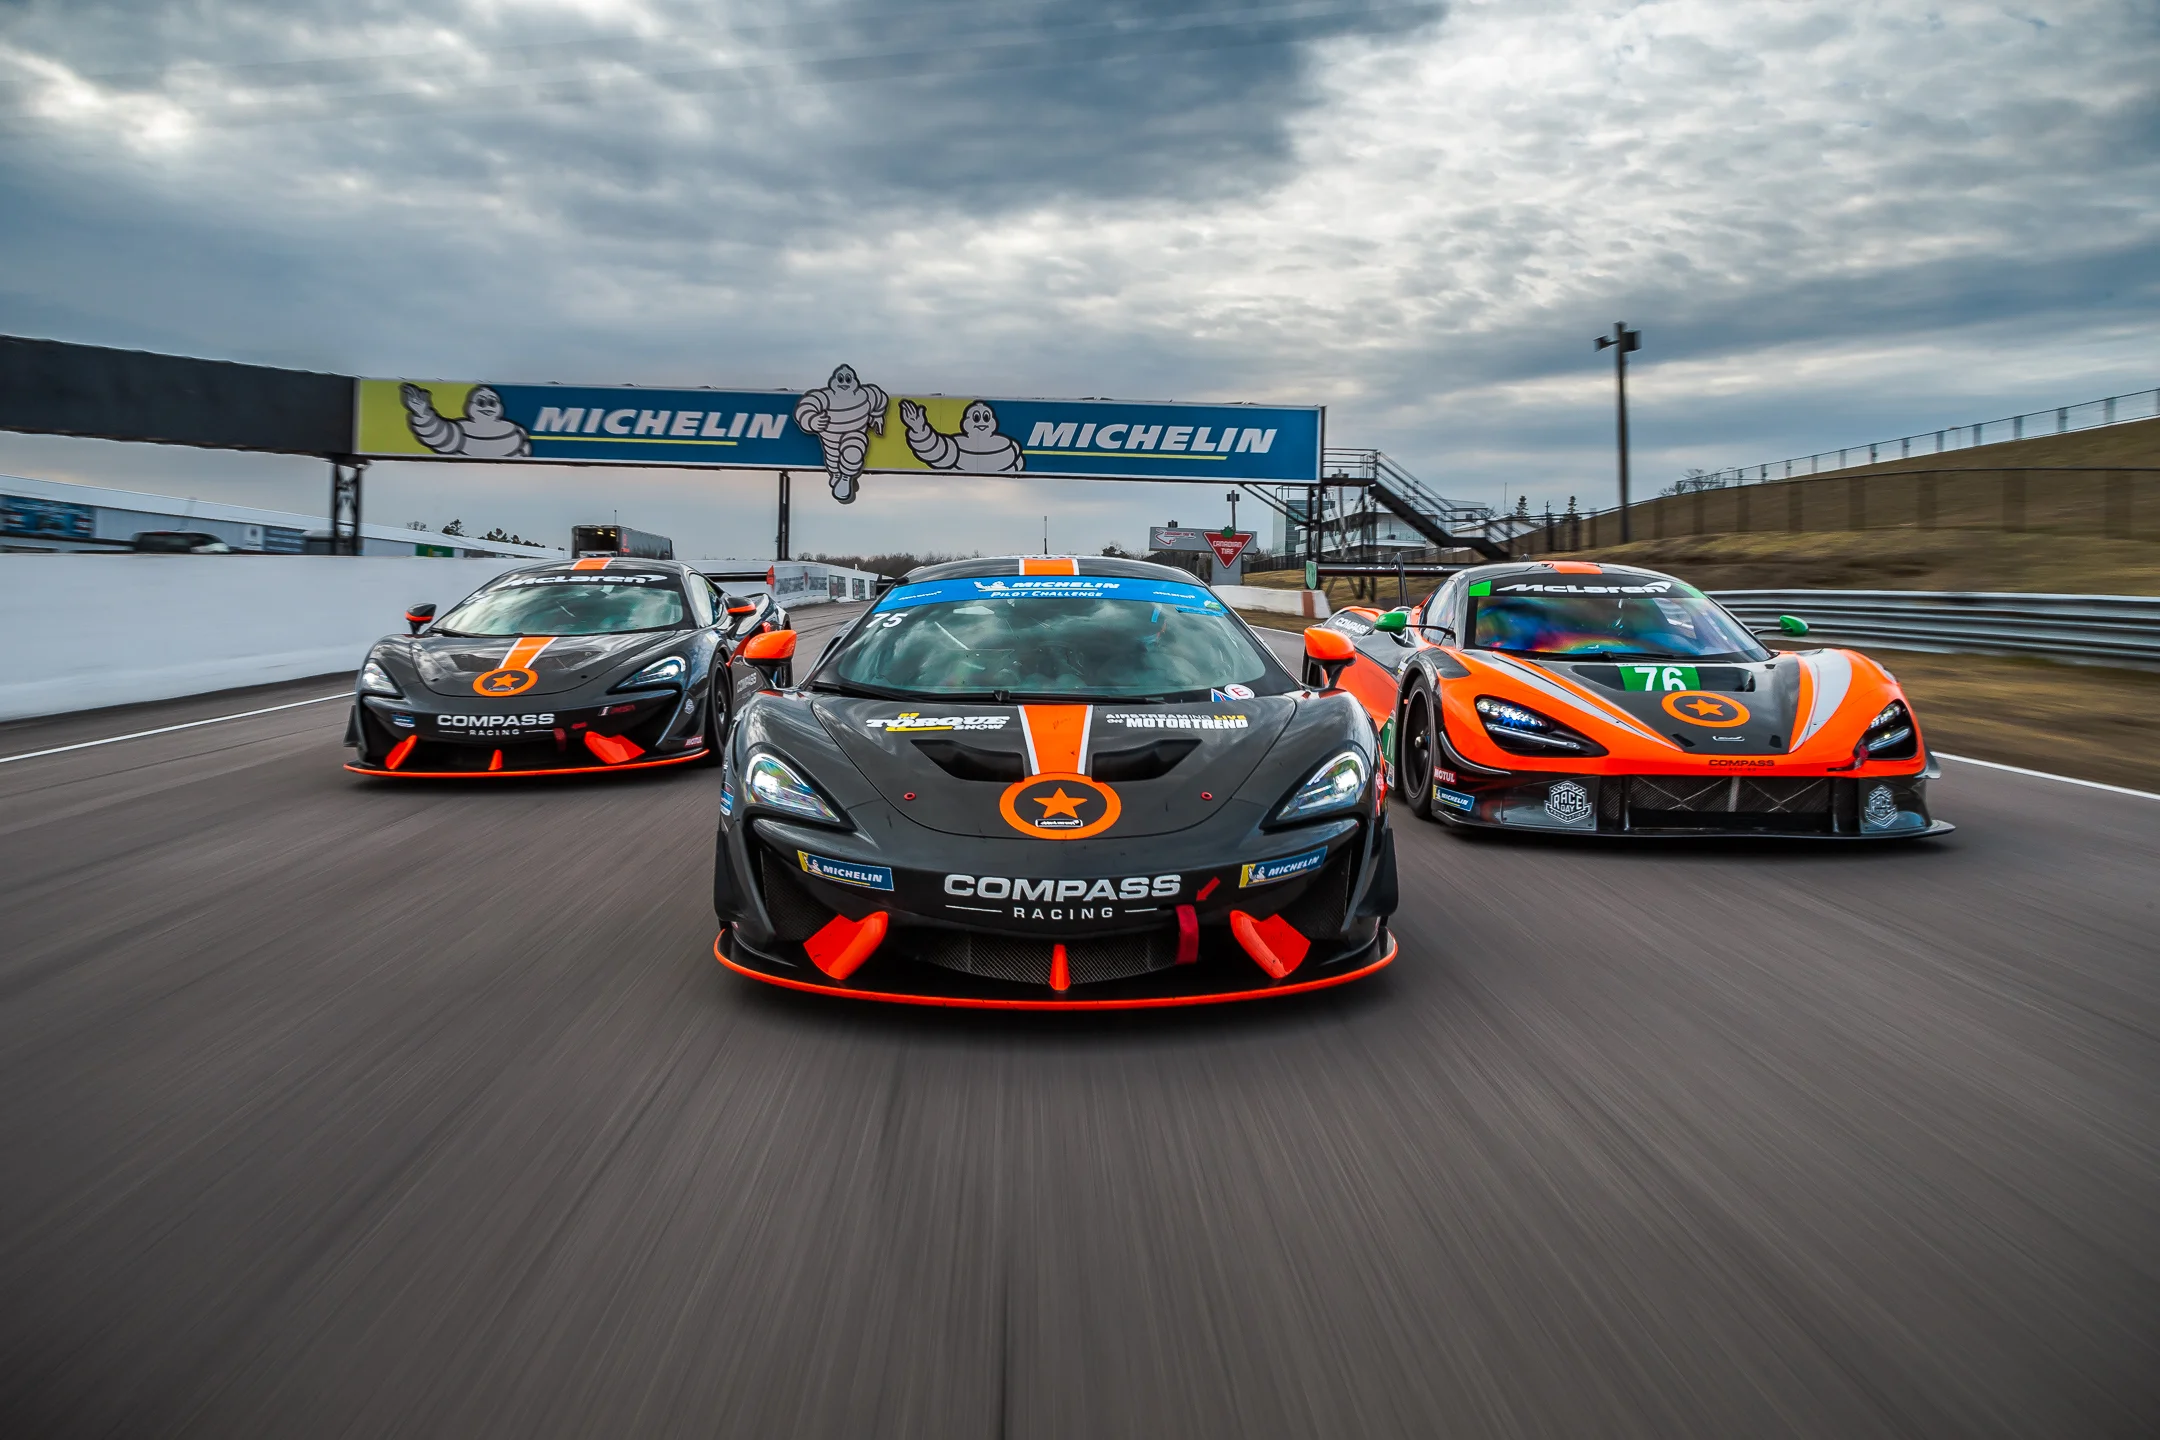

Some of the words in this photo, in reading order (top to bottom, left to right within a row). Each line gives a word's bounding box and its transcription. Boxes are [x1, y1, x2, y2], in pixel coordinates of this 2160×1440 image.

[533, 407, 789, 439] MICHELIN
[1026, 421, 1278, 453] MICHELIN
[1212, 540, 1243, 548] CANADIAN
[1221, 547, 1234, 555] TIRE
[1012, 581, 1120, 589] MICHELIN
[1496, 581, 1672, 594] McLaren
[1031, 590, 1104, 598] CHALLENGE
[866, 612, 909, 628] 75
[1335, 616, 1370, 635] COMPASS
[1633, 666, 1687, 692] 76
[1231, 687, 1248, 697] E
[436, 713, 555, 727] COMPASS
[866, 715, 1010, 728] TORQUE
[1126, 718, 1249, 729] MOTORTREND
[1708, 759, 1775, 767] COMPASS
[1434, 768, 1455, 783] MOTUL
[1441, 793, 1469, 806] MICHELIN
[1553, 791, 1583, 810] RACE
[1560, 804, 1575, 813] DAY
[1268, 855, 1320, 877] MICHELIN
[822, 865, 883, 883] MICHELIN
[944, 874, 1182, 902] COMPASS
[1013, 906, 1114, 920] RACING
